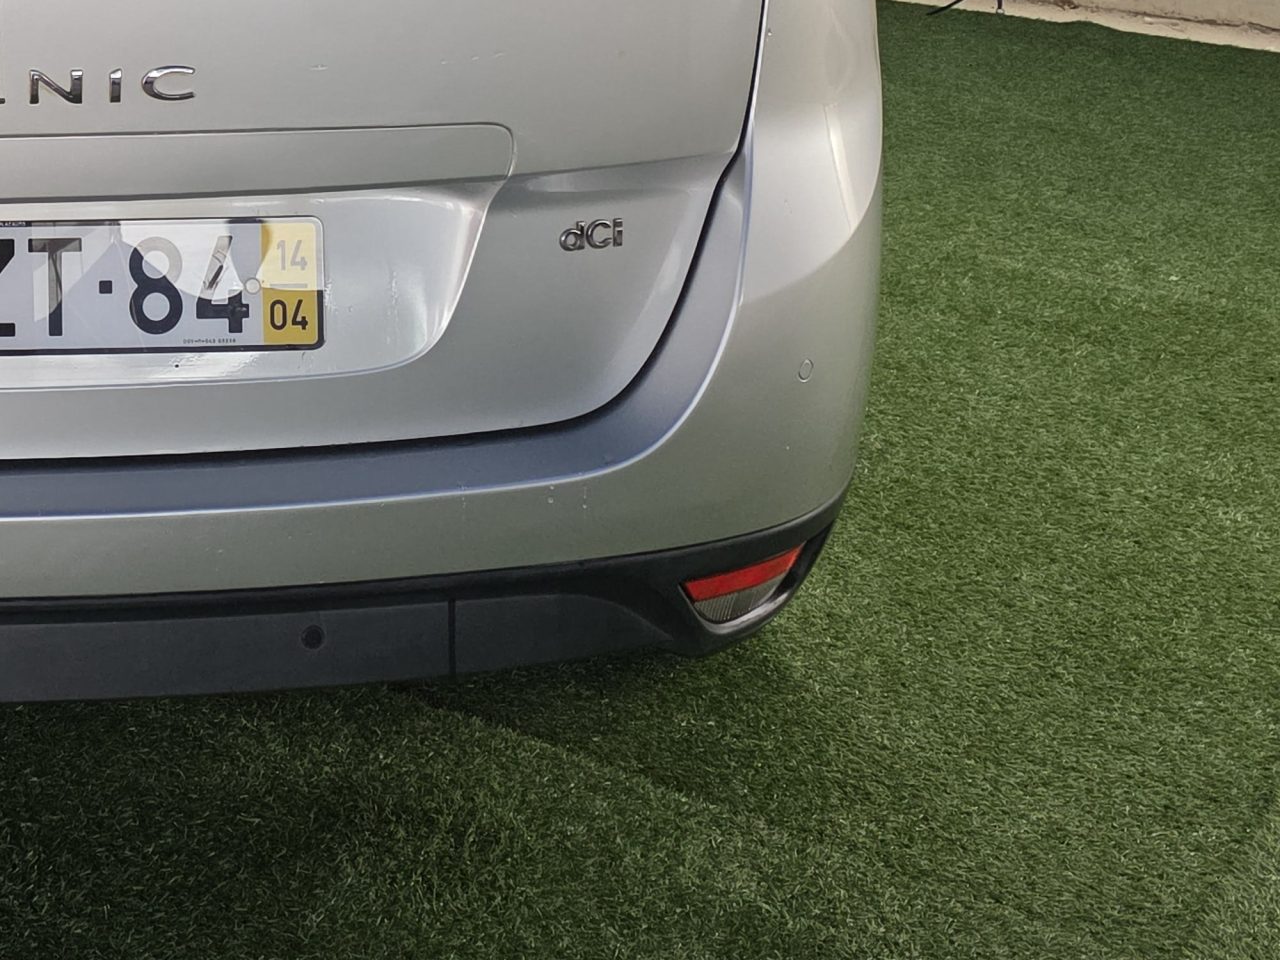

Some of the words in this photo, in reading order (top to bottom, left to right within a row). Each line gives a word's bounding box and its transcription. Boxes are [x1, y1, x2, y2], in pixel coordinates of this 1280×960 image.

[559, 218, 623, 251] dCi
[276, 239, 309, 271] 14
[269, 299, 309, 331] 04
